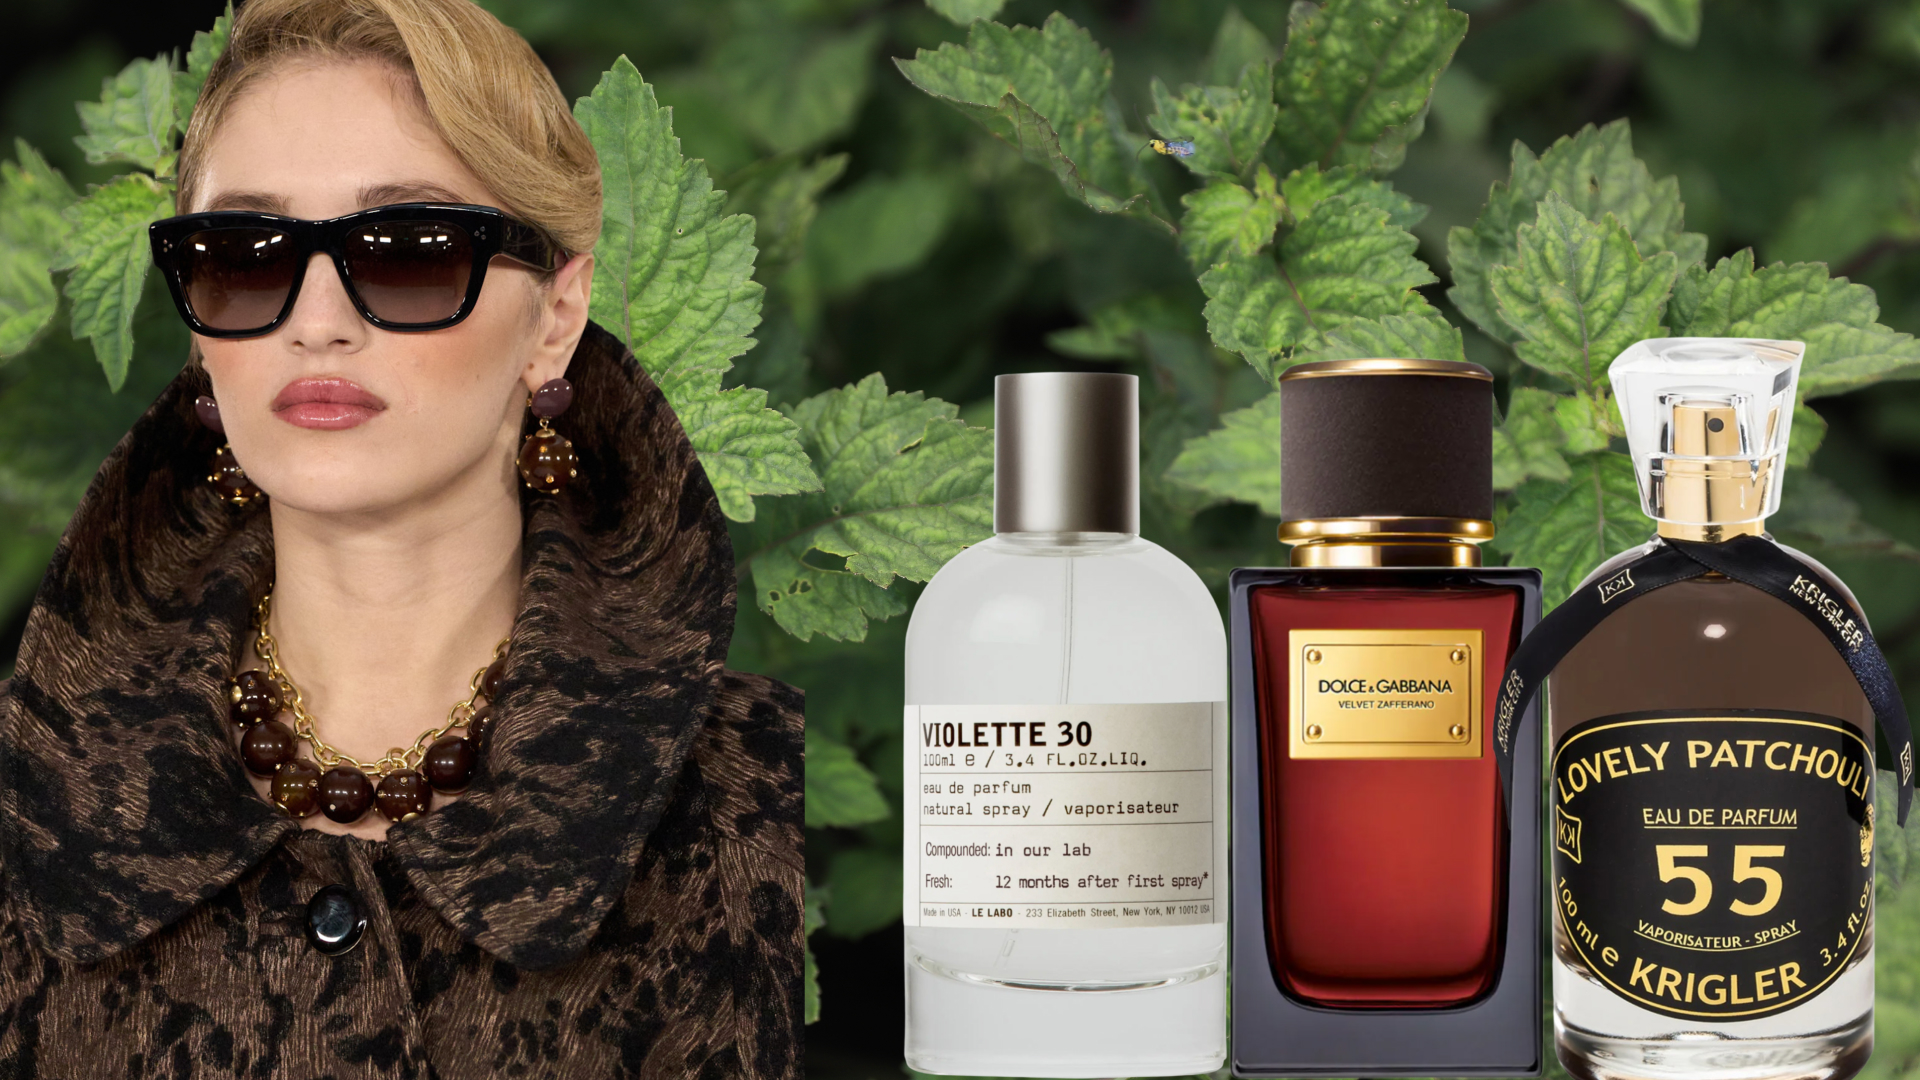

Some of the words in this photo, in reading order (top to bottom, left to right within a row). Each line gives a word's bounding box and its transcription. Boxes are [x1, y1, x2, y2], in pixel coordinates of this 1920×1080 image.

[1788, 584, 1816, 605] NEW
[1817, 602, 1842, 631] YORK
[1841, 629, 1859, 653] CITY
[1793, 574, 1864, 648] KRIGLER
[1318, 679, 1367, 693] DOLCE
[1368, 685, 1375, 693] &
[1376, 679, 1453, 693] GABBANA
[1338, 700, 1375, 709] VELVET
[1376, 700, 1435, 709] ZAFFERANO
[923, 722, 1047, 747] VIOLETTE
[1057, 721, 1092, 747] 30
[923, 753, 956, 767] 100ml
[985, 750, 995, 768] /
[1005, 753, 1034, 768] 3.4
[1047, 752, 1147, 767] FL.OZ.LIQ.
[1557, 742, 1671, 805] LOVELY
[1688, 740, 1871, 801] PATCHOULI
[923, 784, 942, 794] eau
[949, 781, 964, 794] de
[973, 780, 1032, 797] parfum
[923, 802, 973, 816] natural
[982, 804, 1031, 818] spray
[1042, 799, 1053, 817] /
[1064, 801, 1180, 818] vaporisateur
[1643, 808, 1681, 825] EAU
[1688, 808, 1715, 825] DE
[1722, 808, 1798, 825] PARFUM
[925, 841, 991, 859] Compounded:
[995, 843, 1013, 857] in
[1023, 846, 1051, 857] our
[1062, 843, 1092, 857] lab
[925, 873, 953, 889] Fresh:
[995, 875, 1011, 889] 12
[1018, 875, 1070, 889] months
[1077, 874, 1120, 889] after
[1127, 874, 1165, 889] first
[1655, 845, 1787, 917] 55
[923, 907, 937, 917] Made
[939, 907, 946, 917] in
[947, 908, 962, 917] USA
[971, 907, 984, 918] LE
[987, 907, 1013, 918] LABO
[1025, 908, 1043, 918] 233
[1047, 907, 1086, 918] Elizabeth
[1090, 907, 1119, 918] Street,
[1122, 906, 1140, 917] New
[1143, 906, 1163, 917] York,
[1165, 906, 1176, 916] NY
[1179, 904, 1199, 915] 10012
[1200, 904, 1210, 914] USA
[1558, 876, 1578, 917] 100
[1576, 919, 1599, 951] ml
[1638, 919, 1743, 948] VAPORISATEUR
[1754, 919, 1797, 944] SPRAY
[1820, 931, 1848, 967] 3.4
[1629, 957, 1808, 1006] KRIGLER
